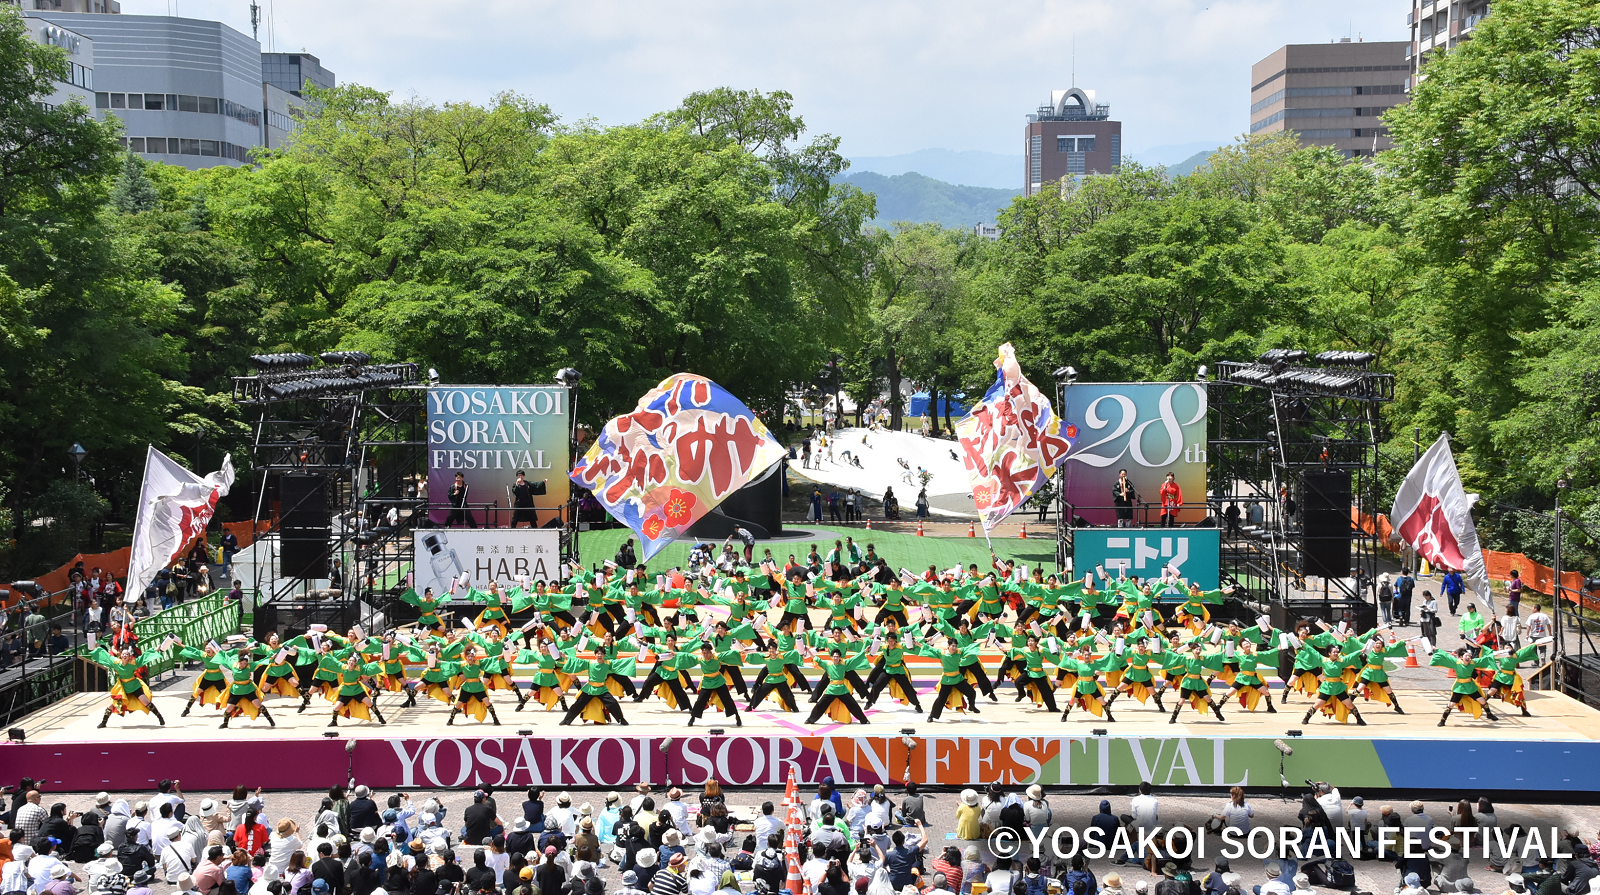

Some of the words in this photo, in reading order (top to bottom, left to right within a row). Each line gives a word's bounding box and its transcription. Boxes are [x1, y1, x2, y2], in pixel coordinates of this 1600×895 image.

[428, 390, 564, 415] YOSAKOI
[430, 420, 534, 444] SORAN
[431, 450, 552, 470] FESTIVAL
[1104, 537, 1189, 569] ニトリ
[475, 557, 549, 581] HABA
[387, 737, 658, 787] YOSAKOI
[681, 736, 900, 786] SORAN
[920, 737, 1249, 786] FESTIVAL
